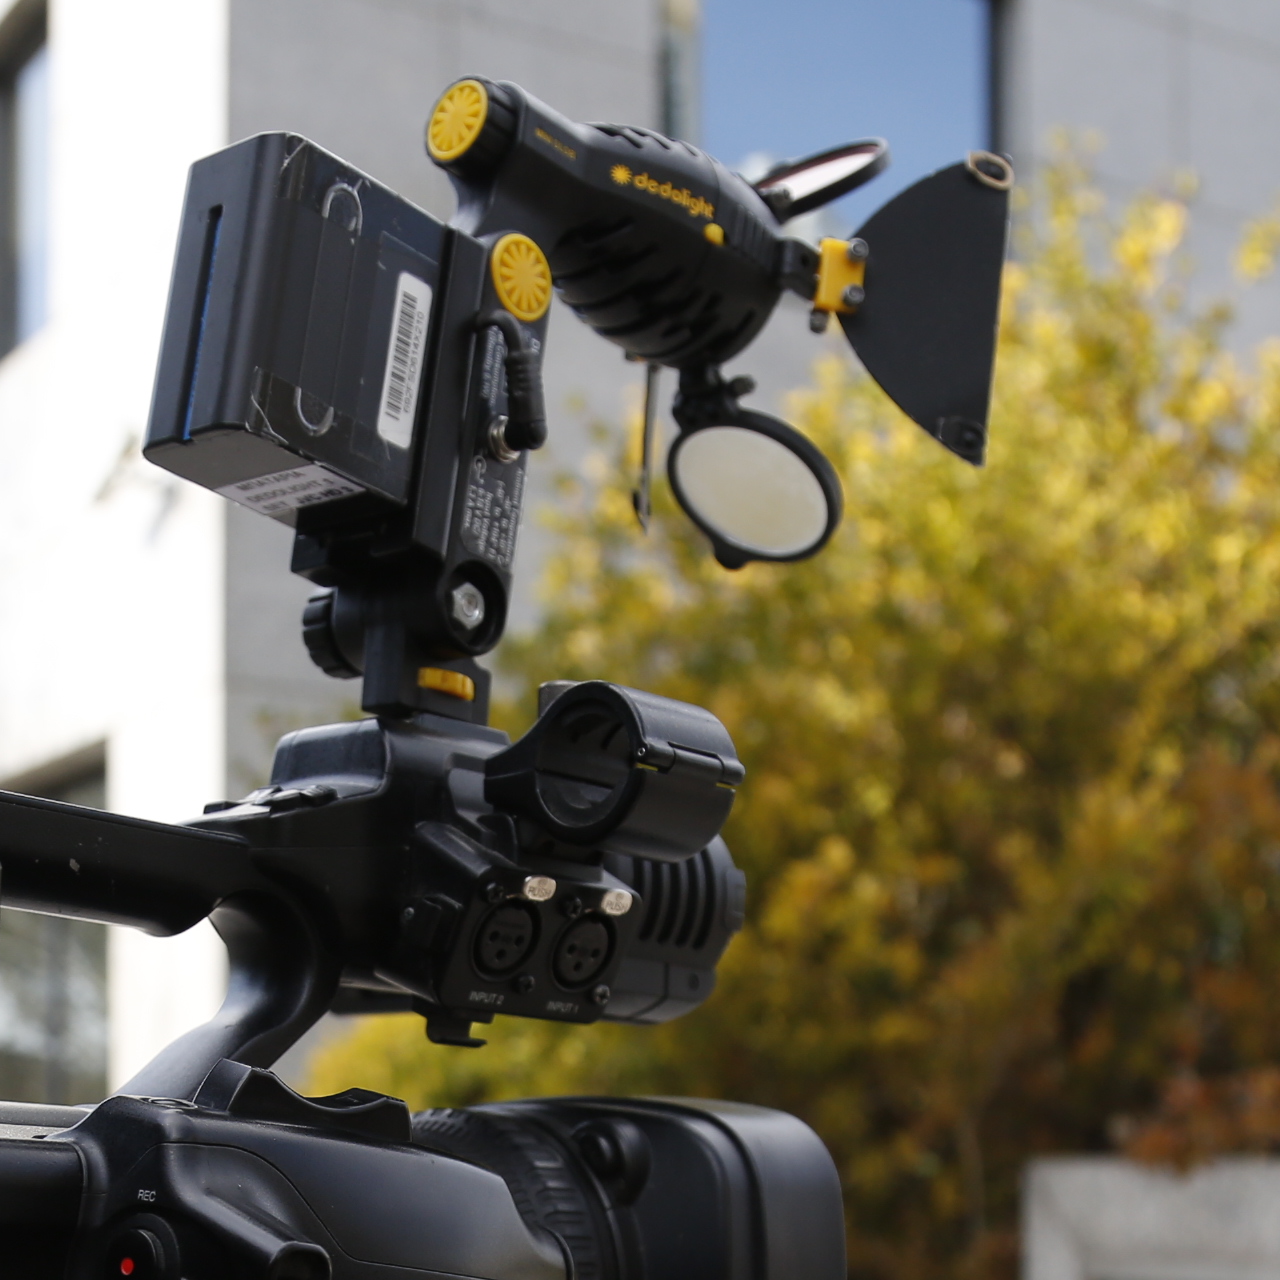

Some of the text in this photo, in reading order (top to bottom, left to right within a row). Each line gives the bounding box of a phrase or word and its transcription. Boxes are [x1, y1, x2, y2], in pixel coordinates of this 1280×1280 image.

[634, 172, 716, 220] dedolight
[469, 991, 505, 1006] INPUT 2
[546, 1001, 575, 1013] INPUT
[137, 1189, 156, 1202] REC
